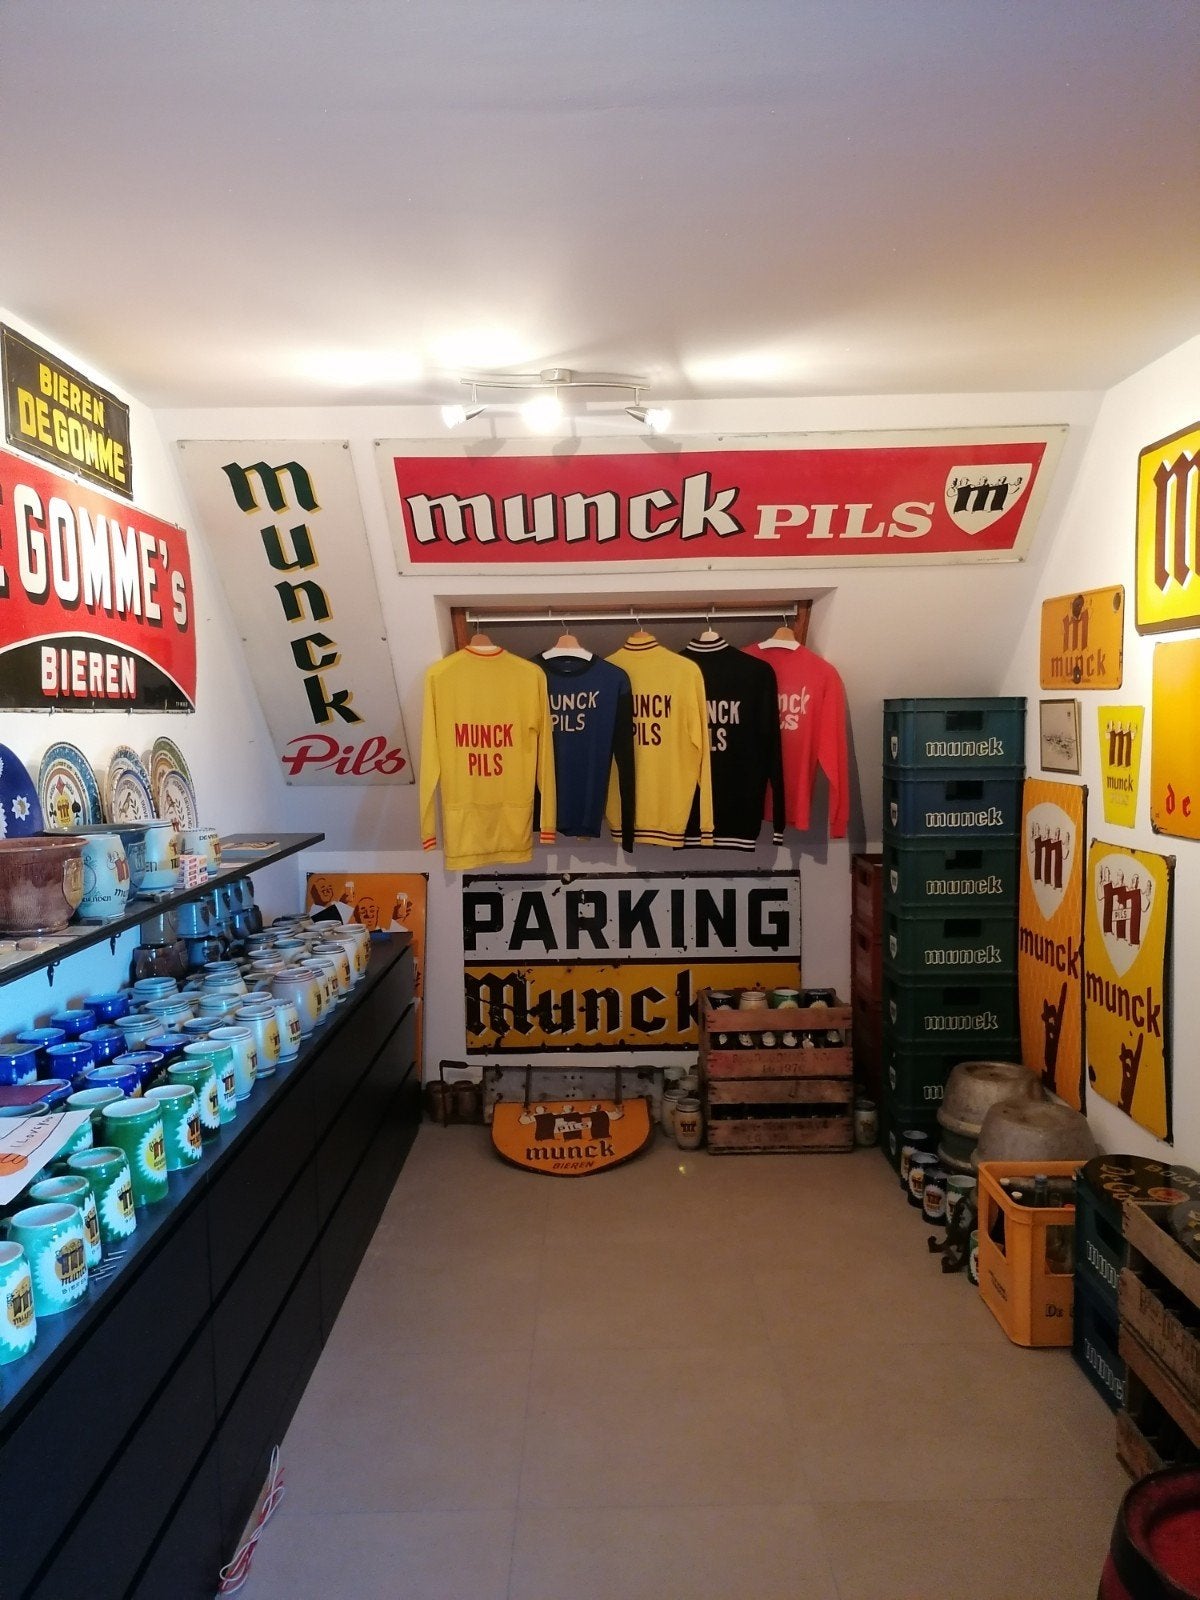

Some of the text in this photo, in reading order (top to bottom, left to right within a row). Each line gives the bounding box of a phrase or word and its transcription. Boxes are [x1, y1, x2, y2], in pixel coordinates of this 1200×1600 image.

[39, 362, 105, 429] BIEREN
[406, 471, 935, 545] munck PILS
[221, 461, 365, 727] munck
[41, 645, 137, 699] BIEREN
[1050, 648, 1106, 678] munck
[550, 690, 600, 712] UNCK
[632, 694, 672, 719] UNCK
[706, 700, 741, 725] NCK
[777, 686, 811, 715] nck
[454, 723, 514, 749] MUNCK
[925, 736, 1005, 757] munck
[281, 734, 406, 776] Pils
[468, 752, 504, 777] PILS
[1106, 774, 1134, 792] munck
[925, 806, 1004, 828] munck
[925, 875, 1004, 895] munck
[463, 887, 790, 951] PARKING
[1114, 912, 1129, 920] PILS
[923, 945, 1002, 965] munck
[1020, 925, 1079, 980] munck
[1085, 969, 1161, 1038] munck
[924, 1011, 999, 1031] munck
[557, 1121, 590, 1133] PILS
[526, 1140, 616, 1161] munck
[552, 1161, 594, 1170] BIEREN
